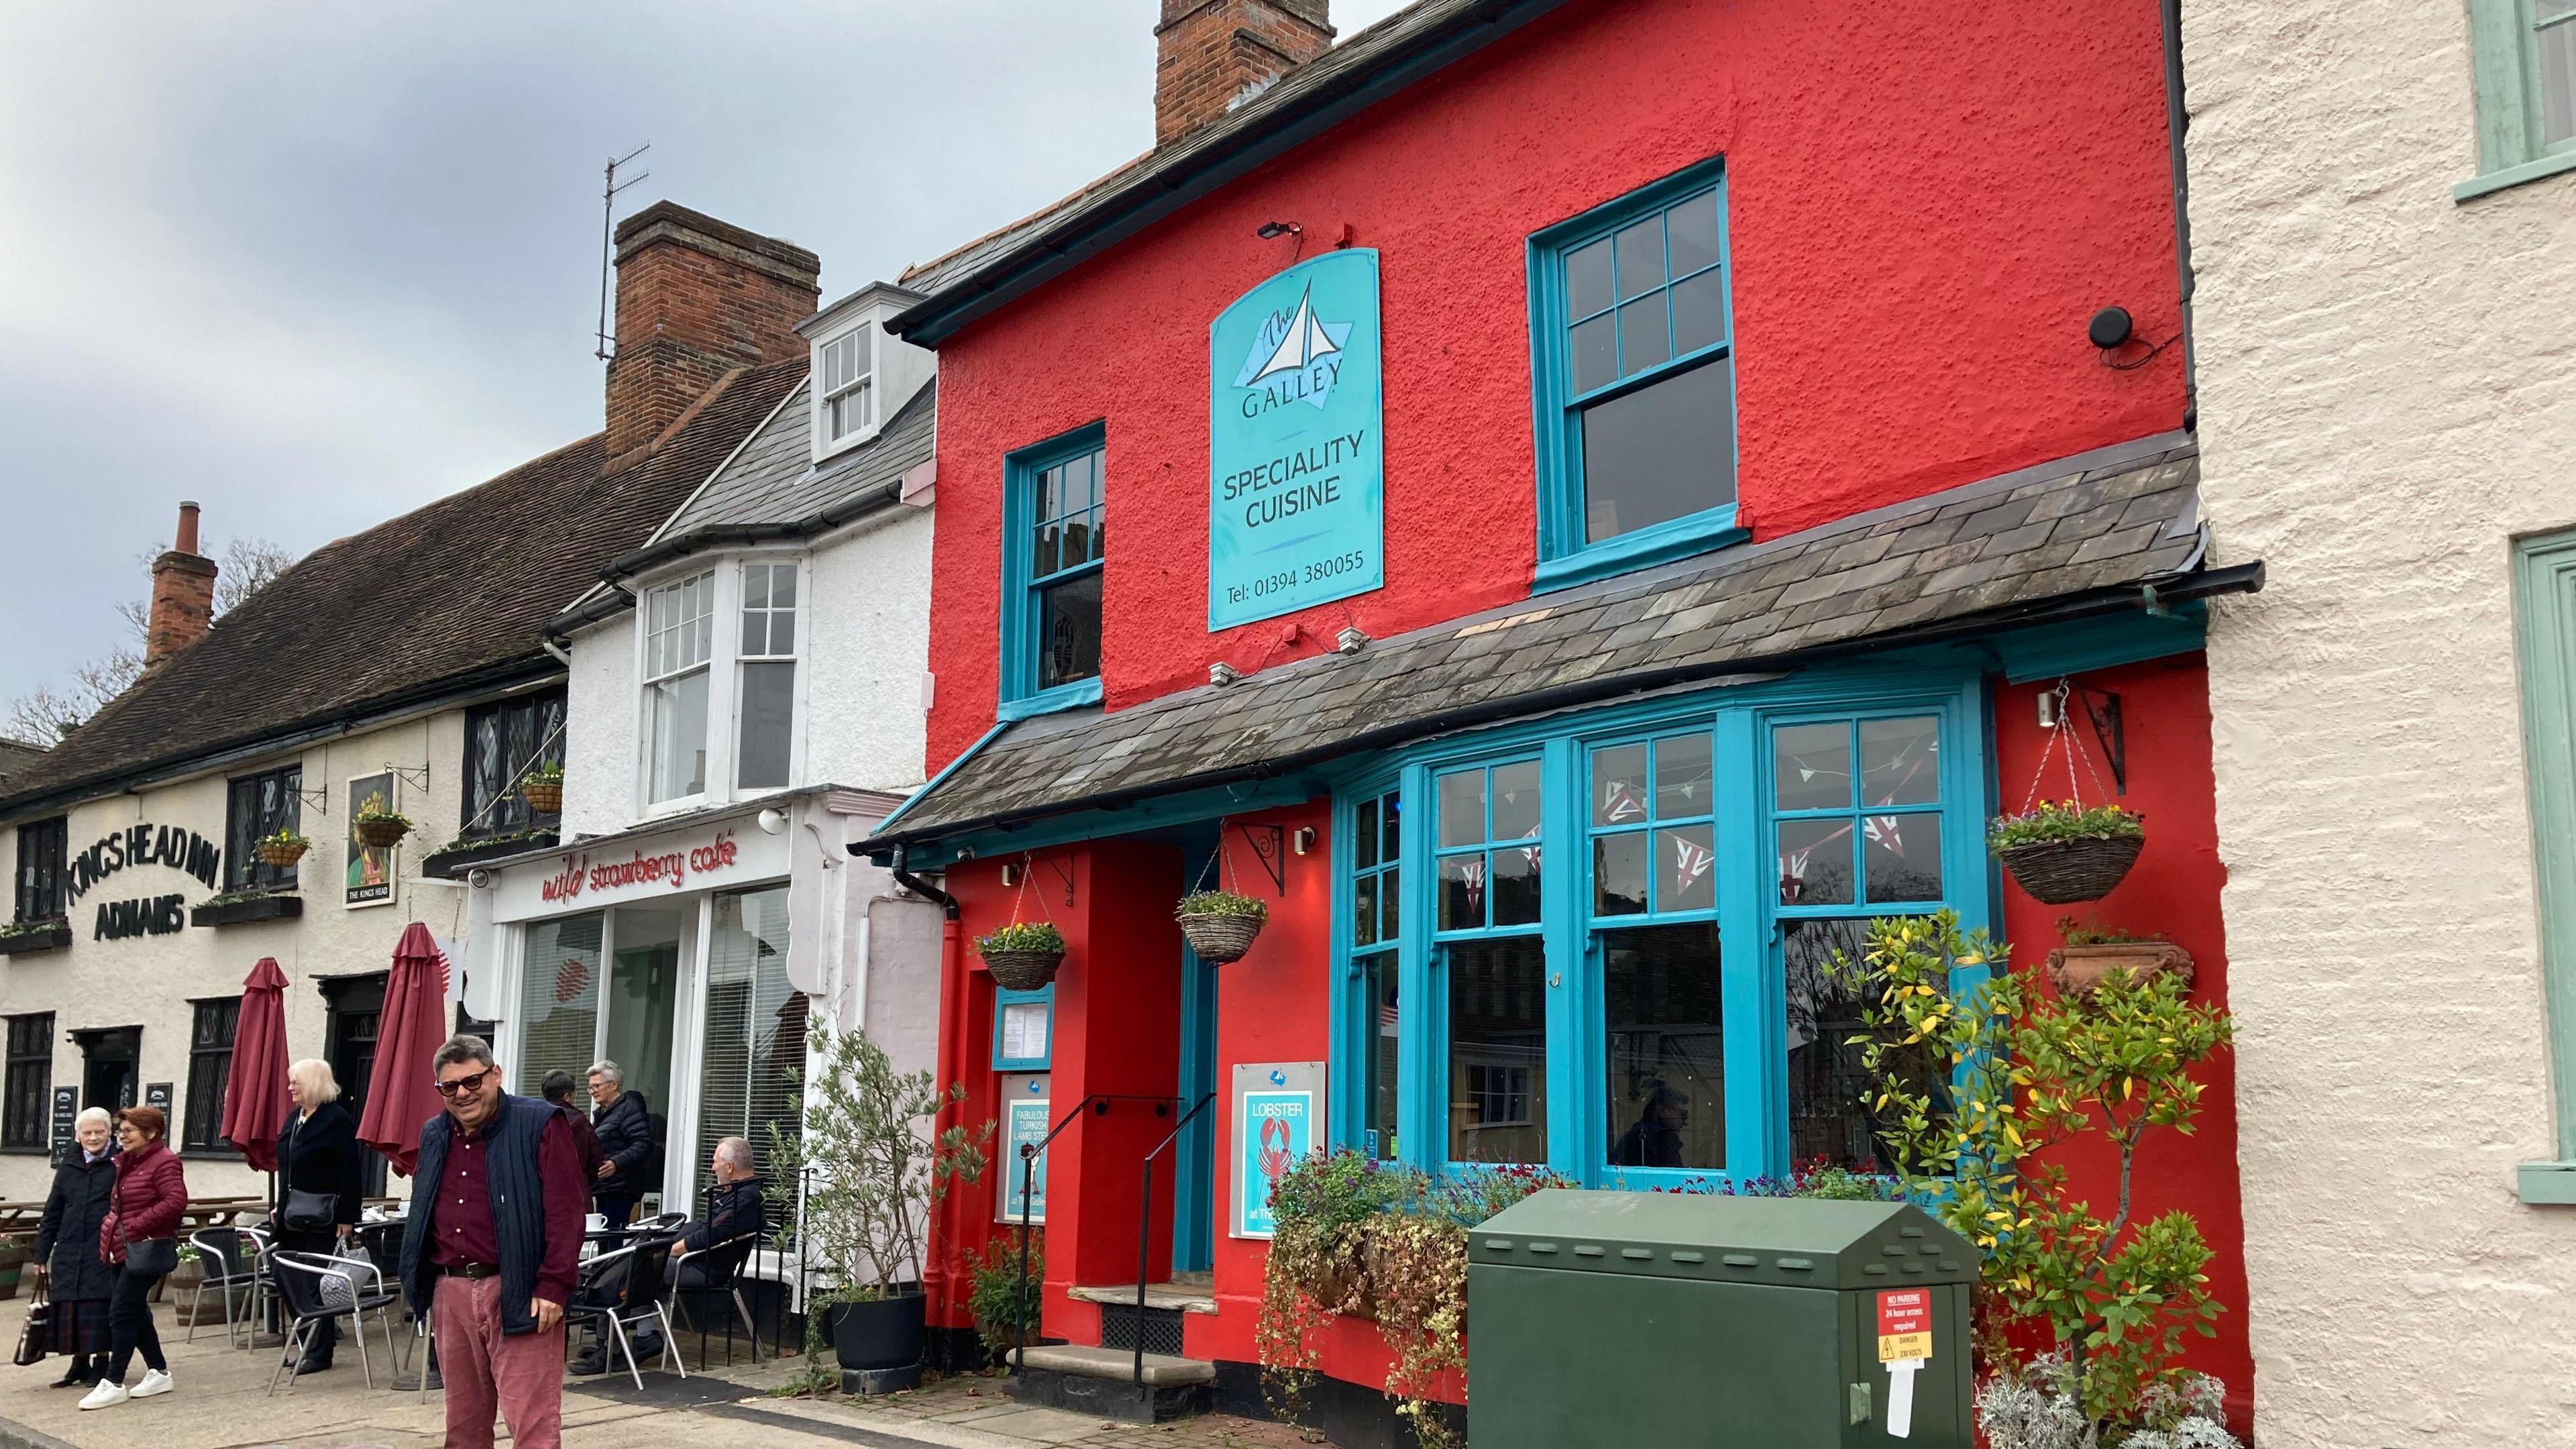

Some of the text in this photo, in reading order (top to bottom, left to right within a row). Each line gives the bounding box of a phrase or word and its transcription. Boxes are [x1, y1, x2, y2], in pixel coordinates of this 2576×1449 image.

[1263, 306, 1294, 346] The
[1242, 359, 1342, 419] GALLEY
[1224, 429, 1364, 501] SPECIALITY
[1246, 475, 1341, 528] CUISINE
[1228, 550, 1364, 604] Tel: 01394 380055
[65, 823, 221, 906] KINGS HEAD INN
[542, 828, 737, 904] wild strawberry café
[350, 886, 388, 900] THE KINGS HEAD
[93, 894, 184, 941] ADNAMS
[1252, 1102, 1303, 1117] LOBSTER
[1019, 1120, 1046, 1130] TURKISH
[1014, 1131, 1031, 1140] LAMB
[1249, 1210, 1257, 1220] at
[1887, 1293, 1920, 1304] NO PARKING
[1886, 1309, 1892, 1318] 24
[1894, 1309, 1906, 1318] hour
[1894, 1320, 1917, 1332] required
[1899, 1336, 1918, 1344] DANGER
[1909, 1348, 1922, 1356] VOLTS
